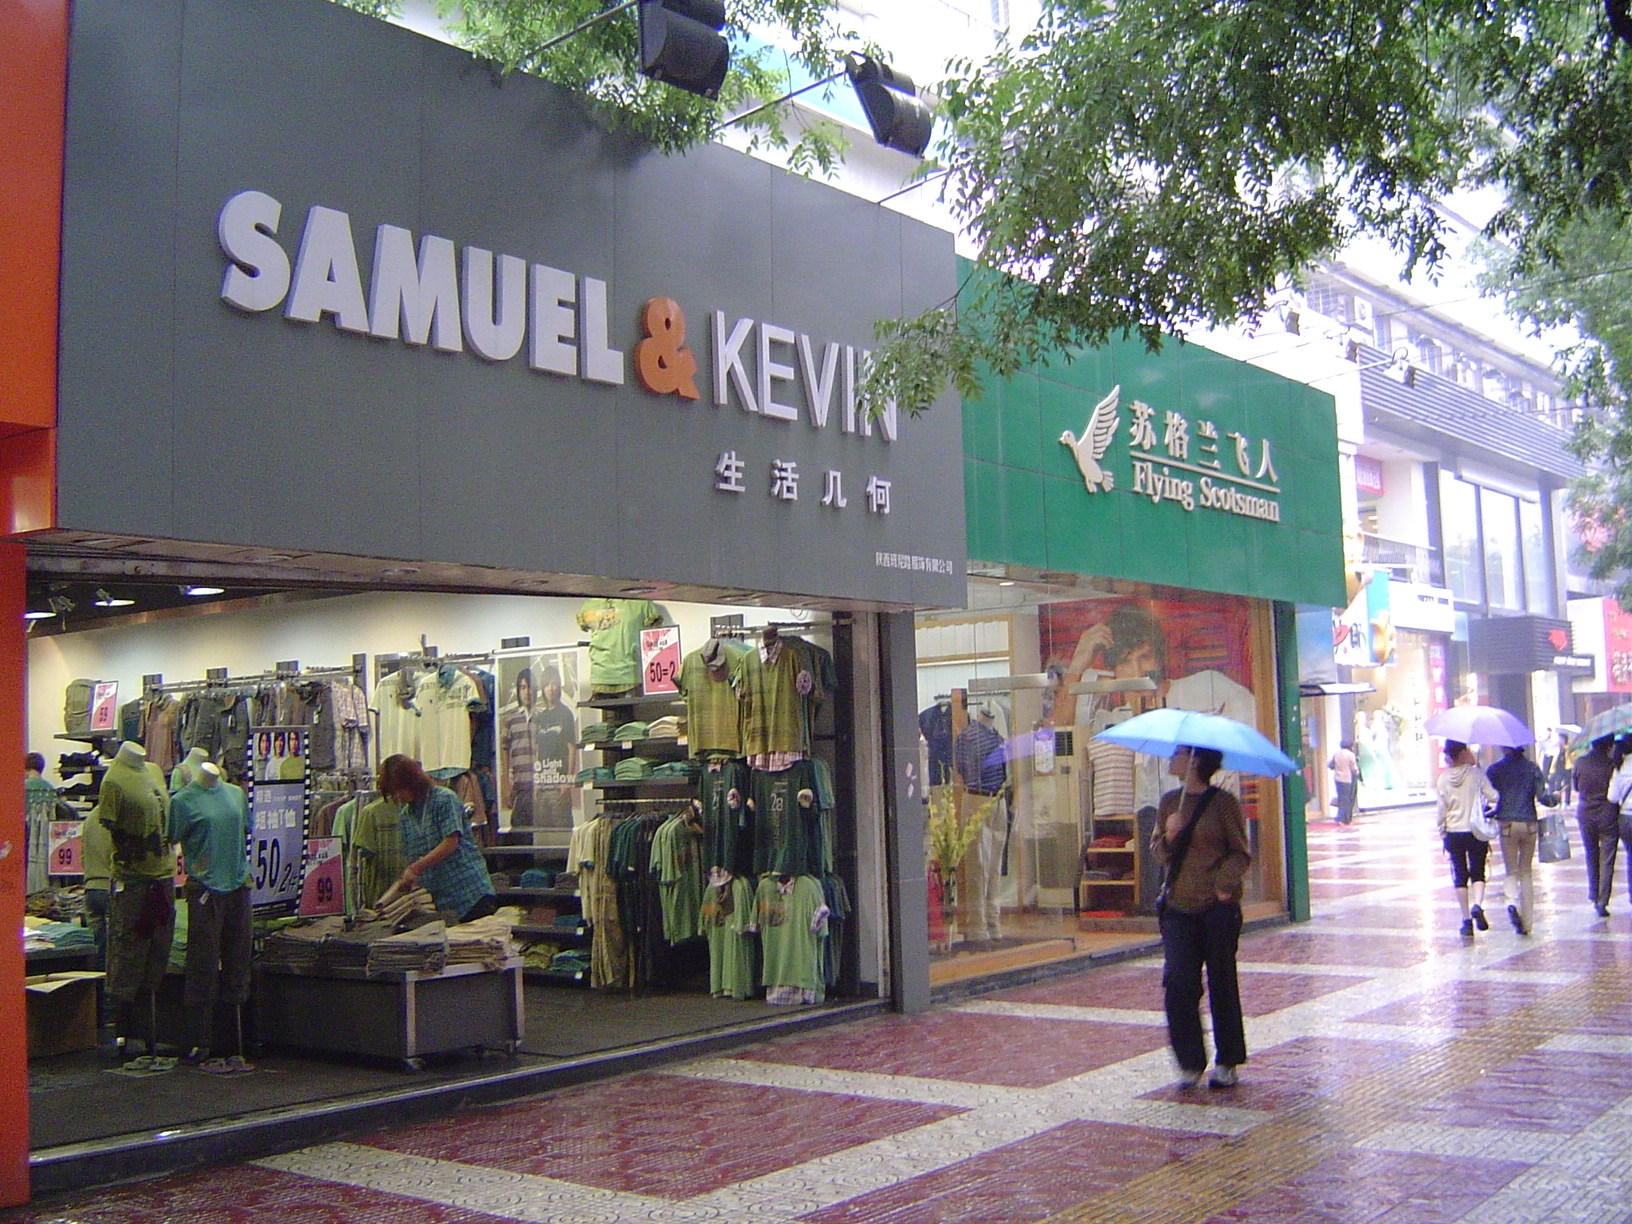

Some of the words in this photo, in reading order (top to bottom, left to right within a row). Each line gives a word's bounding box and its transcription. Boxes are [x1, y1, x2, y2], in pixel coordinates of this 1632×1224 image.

[218, 189, 625, 386] SAMUEL
[635, 296, 700, 400] &
[1128, 400, 1278, 483] 苏格兰飞人
[715, 450, 892, 514] 生活几何
[1132, 460, 1194, 512] Flying
[1200, 476, 1280, 523] Scotsman
[533, 771, 576, 785] Shadow
